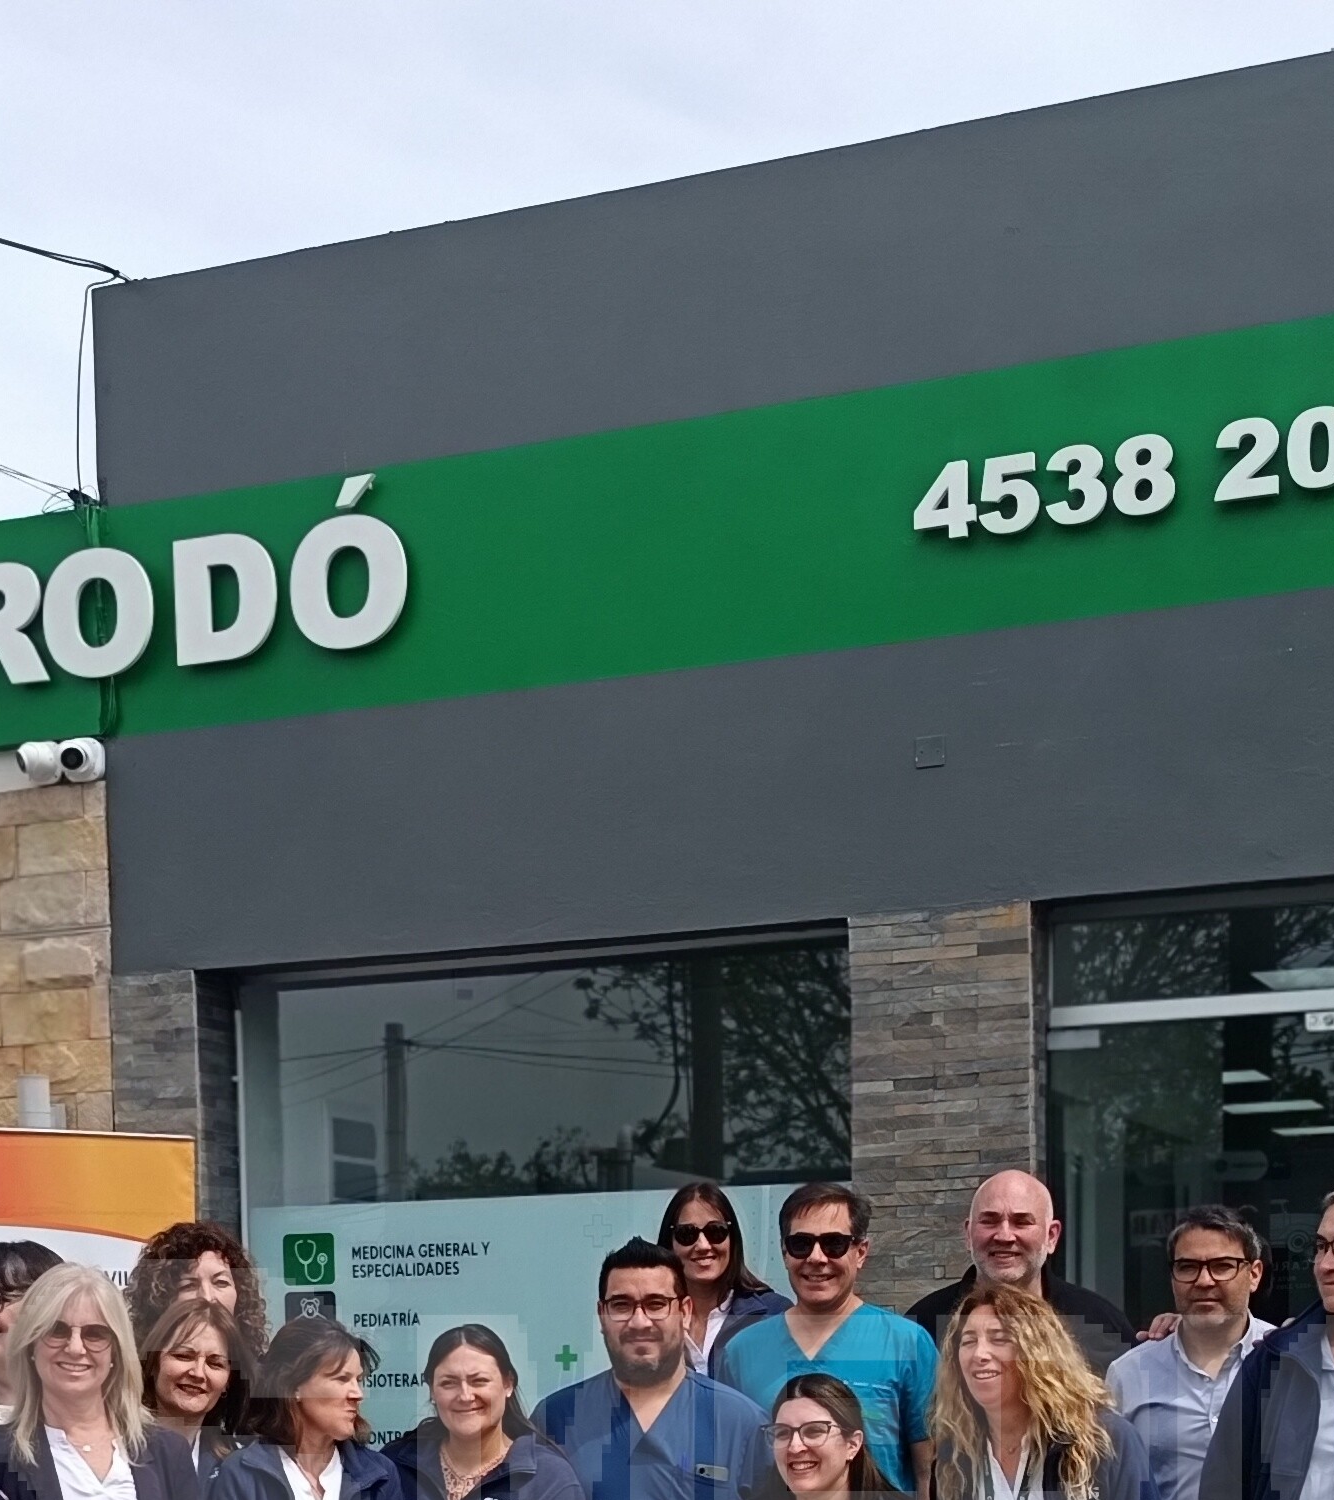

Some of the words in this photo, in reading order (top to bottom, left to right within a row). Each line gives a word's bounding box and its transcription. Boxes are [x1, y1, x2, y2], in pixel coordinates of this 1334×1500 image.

[913, 433, 1176, 538] 4538
[351, 1244, 415, 1260] MEDICINA
[418, 1242, 478, 1258] GENERAL
[481, 1241, 490, 1255] Y
[352, 1261, 460, 1278] ESPECIALIDADES
[353, 1309, 420, 1327] PEDIATRÍA
